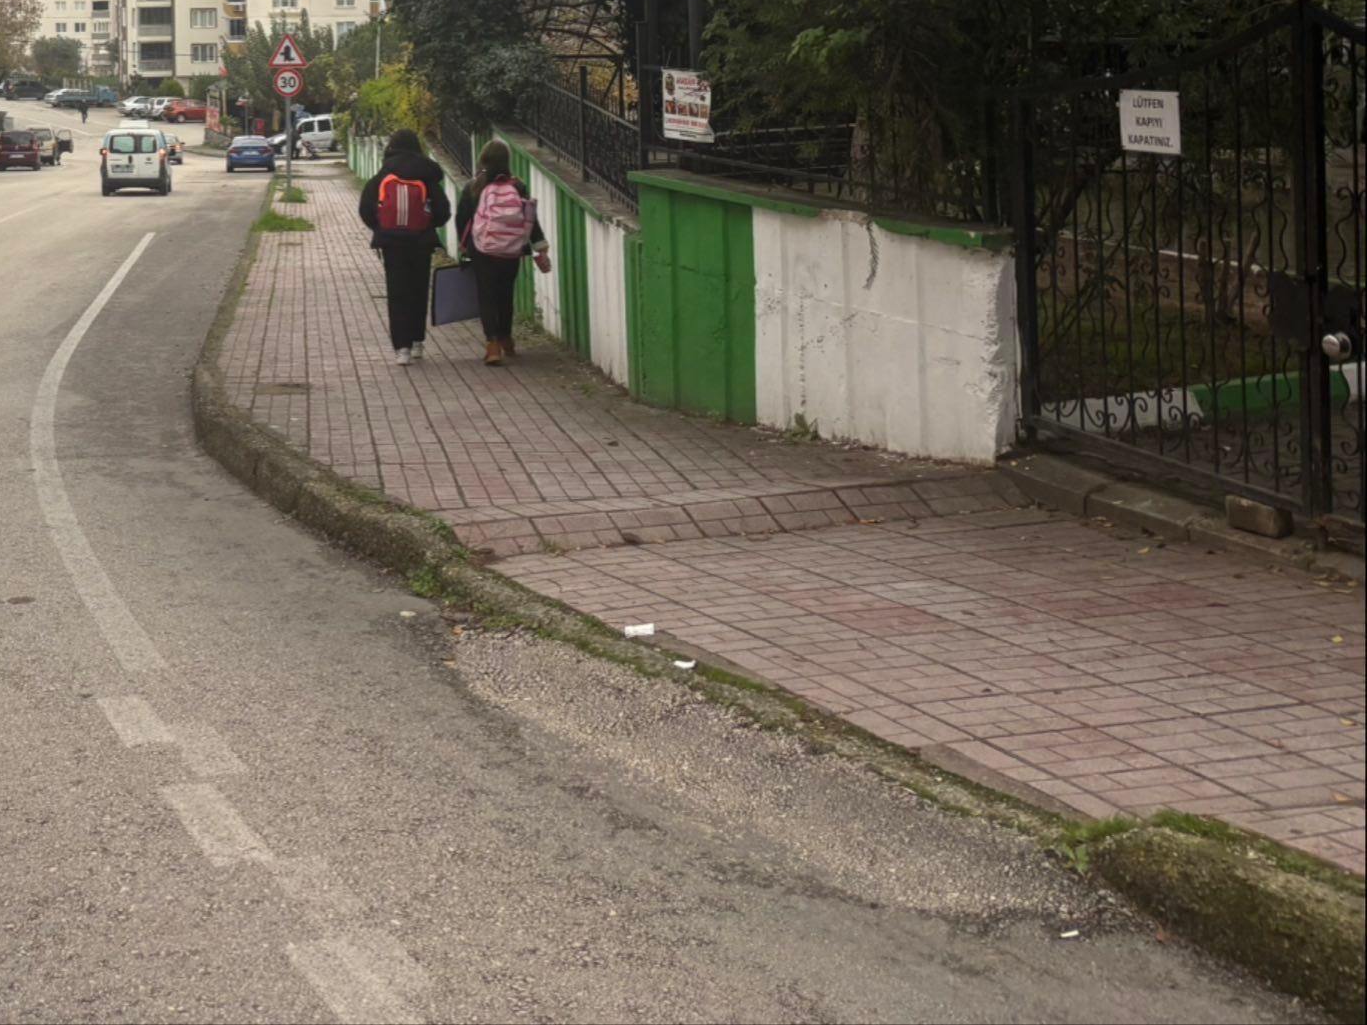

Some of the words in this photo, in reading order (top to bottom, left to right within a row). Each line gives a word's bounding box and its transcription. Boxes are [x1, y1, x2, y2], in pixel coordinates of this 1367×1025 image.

[280, 76, 296, 88] 30
[1132, 96, 1164, 109] LÜTFEN
[1135, 117, 1163, 128] KAPIYI
